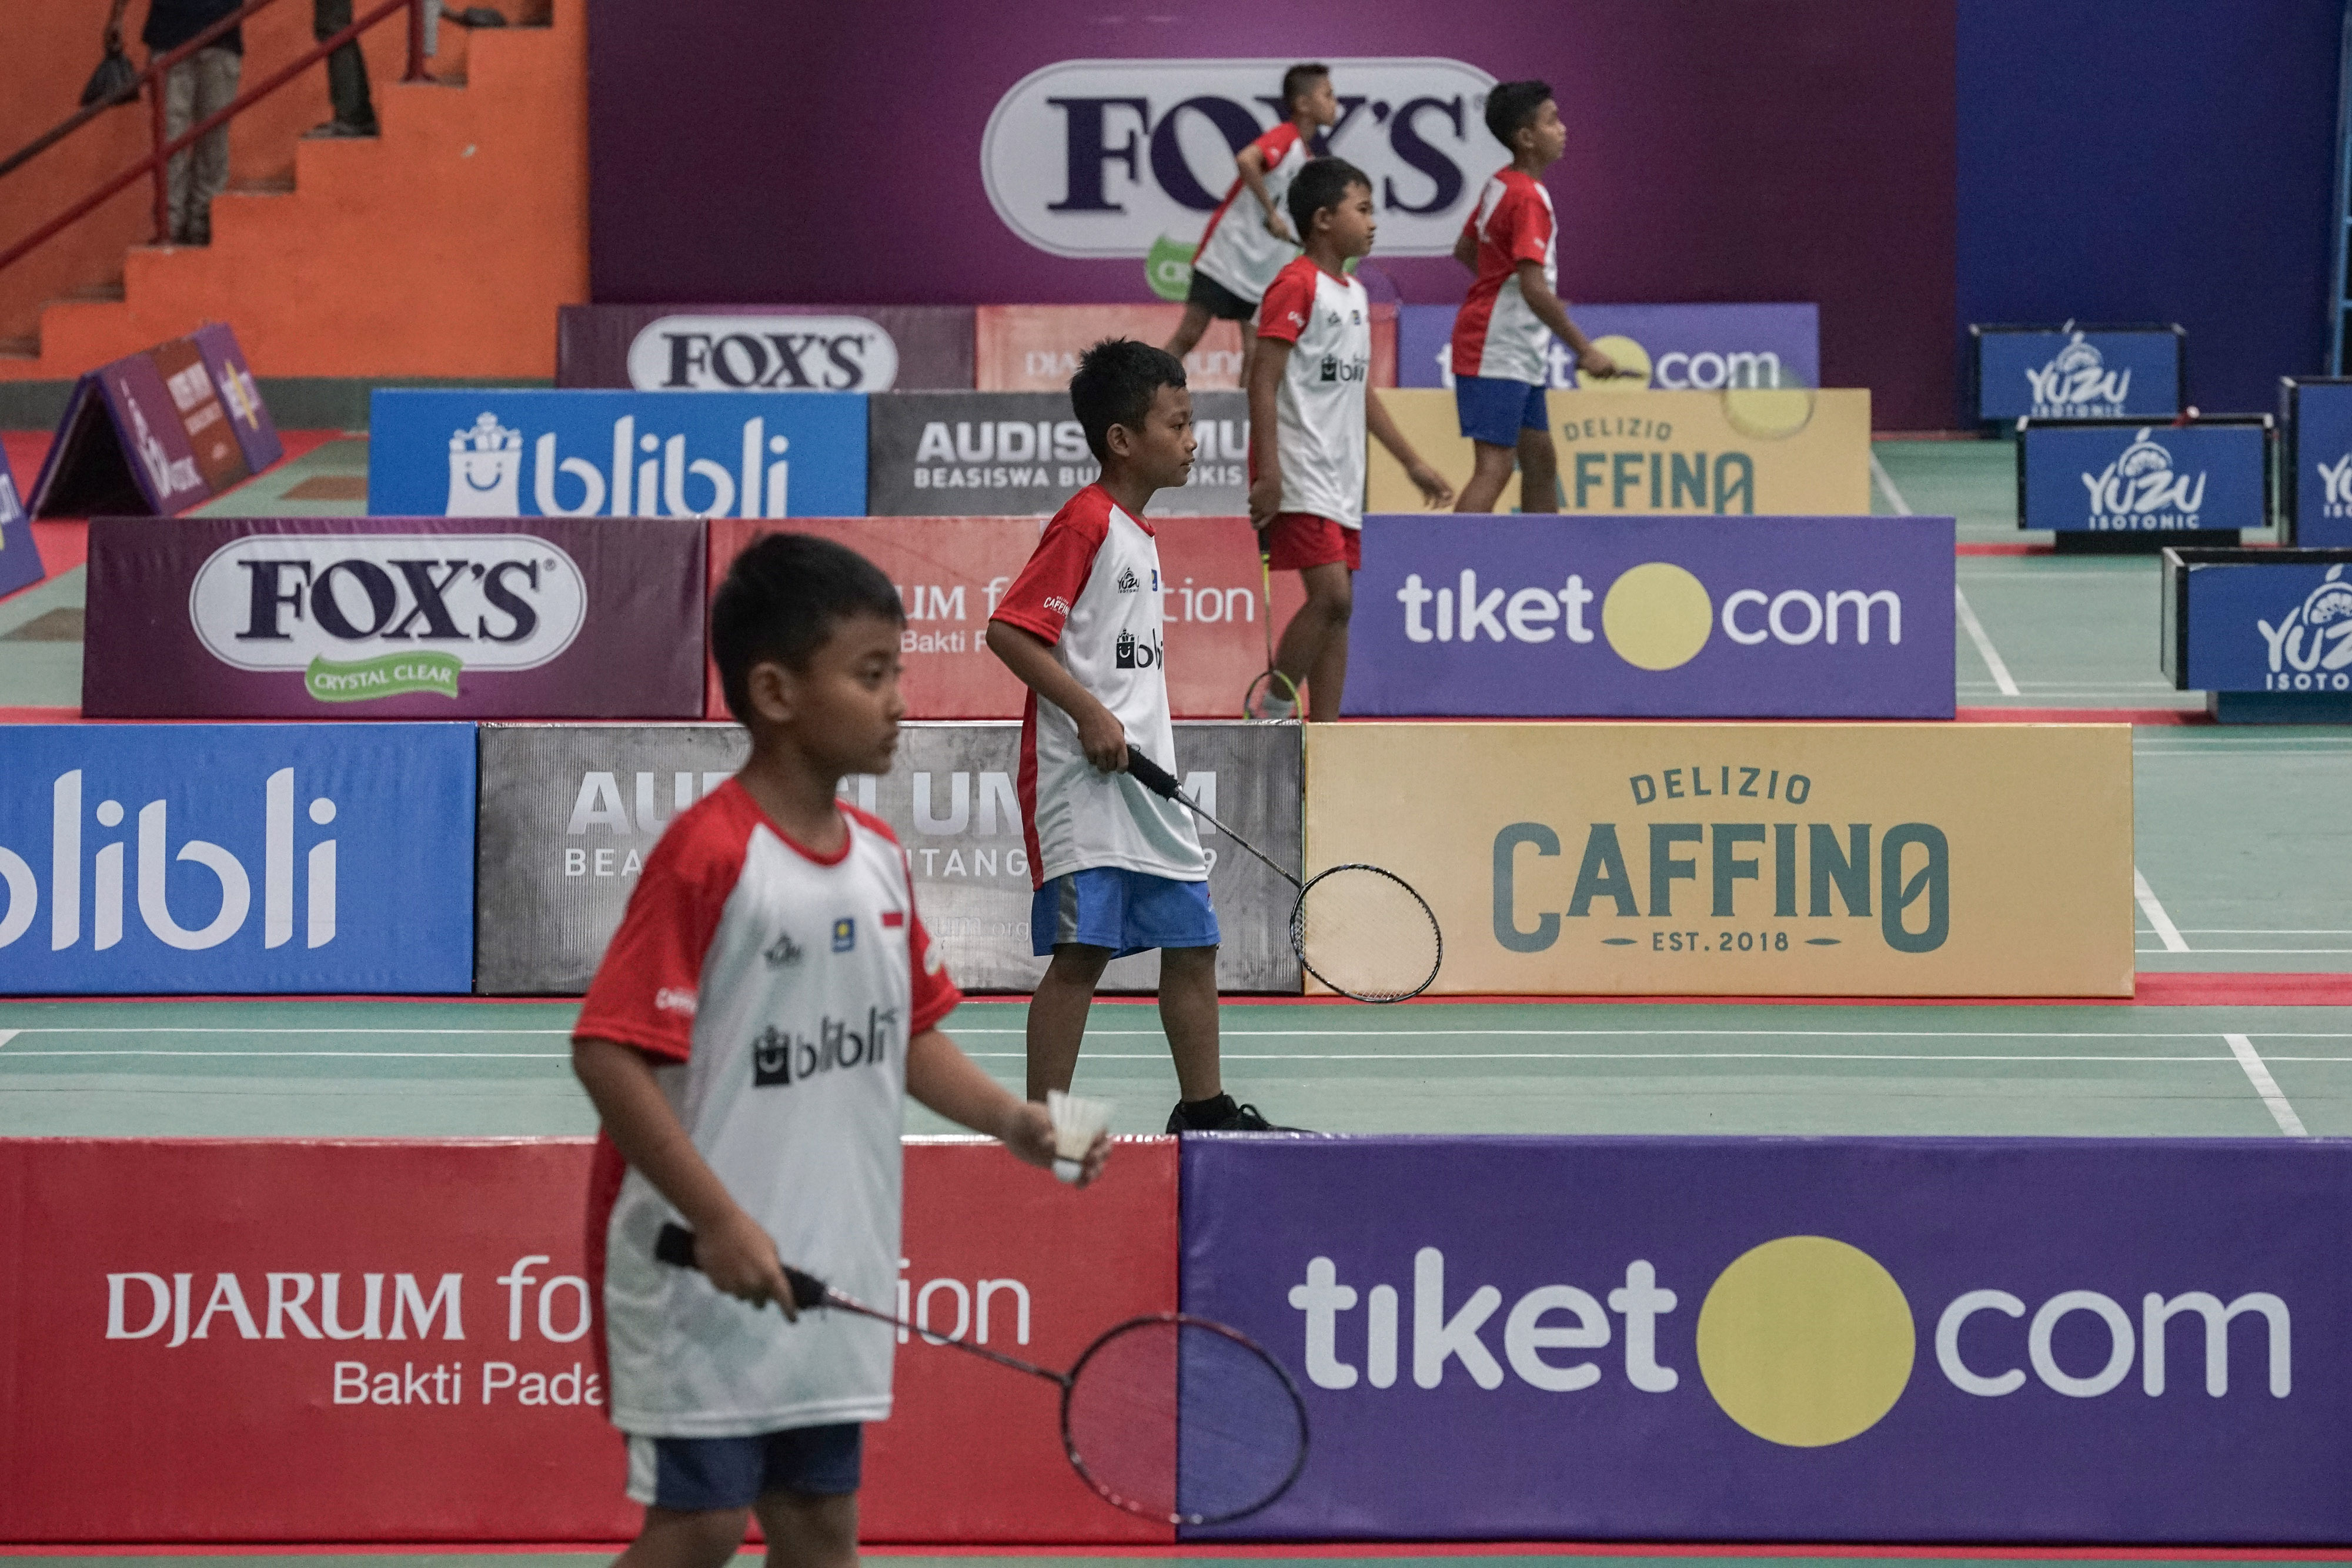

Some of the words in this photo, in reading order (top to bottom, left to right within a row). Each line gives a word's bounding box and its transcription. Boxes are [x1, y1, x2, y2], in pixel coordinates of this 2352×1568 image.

[661, 332, 864, 390] FOX'S
[2026, 360, 2131, 403] YUZU
[916, 420, 1091, 463] AUDIS
[1563, 417, 1673, 442] DELIZIO
[534, 415, 790, 517] blibli
[914, 467, 1050, 489] BEASISWA
[2082, 462, 2206, 515] YUZU
[236, 559, 539, 643] FOX'S
[1117, 577, 1140, 590] YUZU
[1043, 596, 1070, 619] CAFFIN
[900, 630, 966, 653] Bakti
[313, 669, 389, 691] CRYSTAL
[393, 664, 452, 683] CLEAR
[2266, 673, 2350, 691] ISOTO
[1629, 765, 1812, 805] DELIZIO
[106, 1272, 466, 1348] DJARUM
[333, 1361, 463, 1405] Bakti
